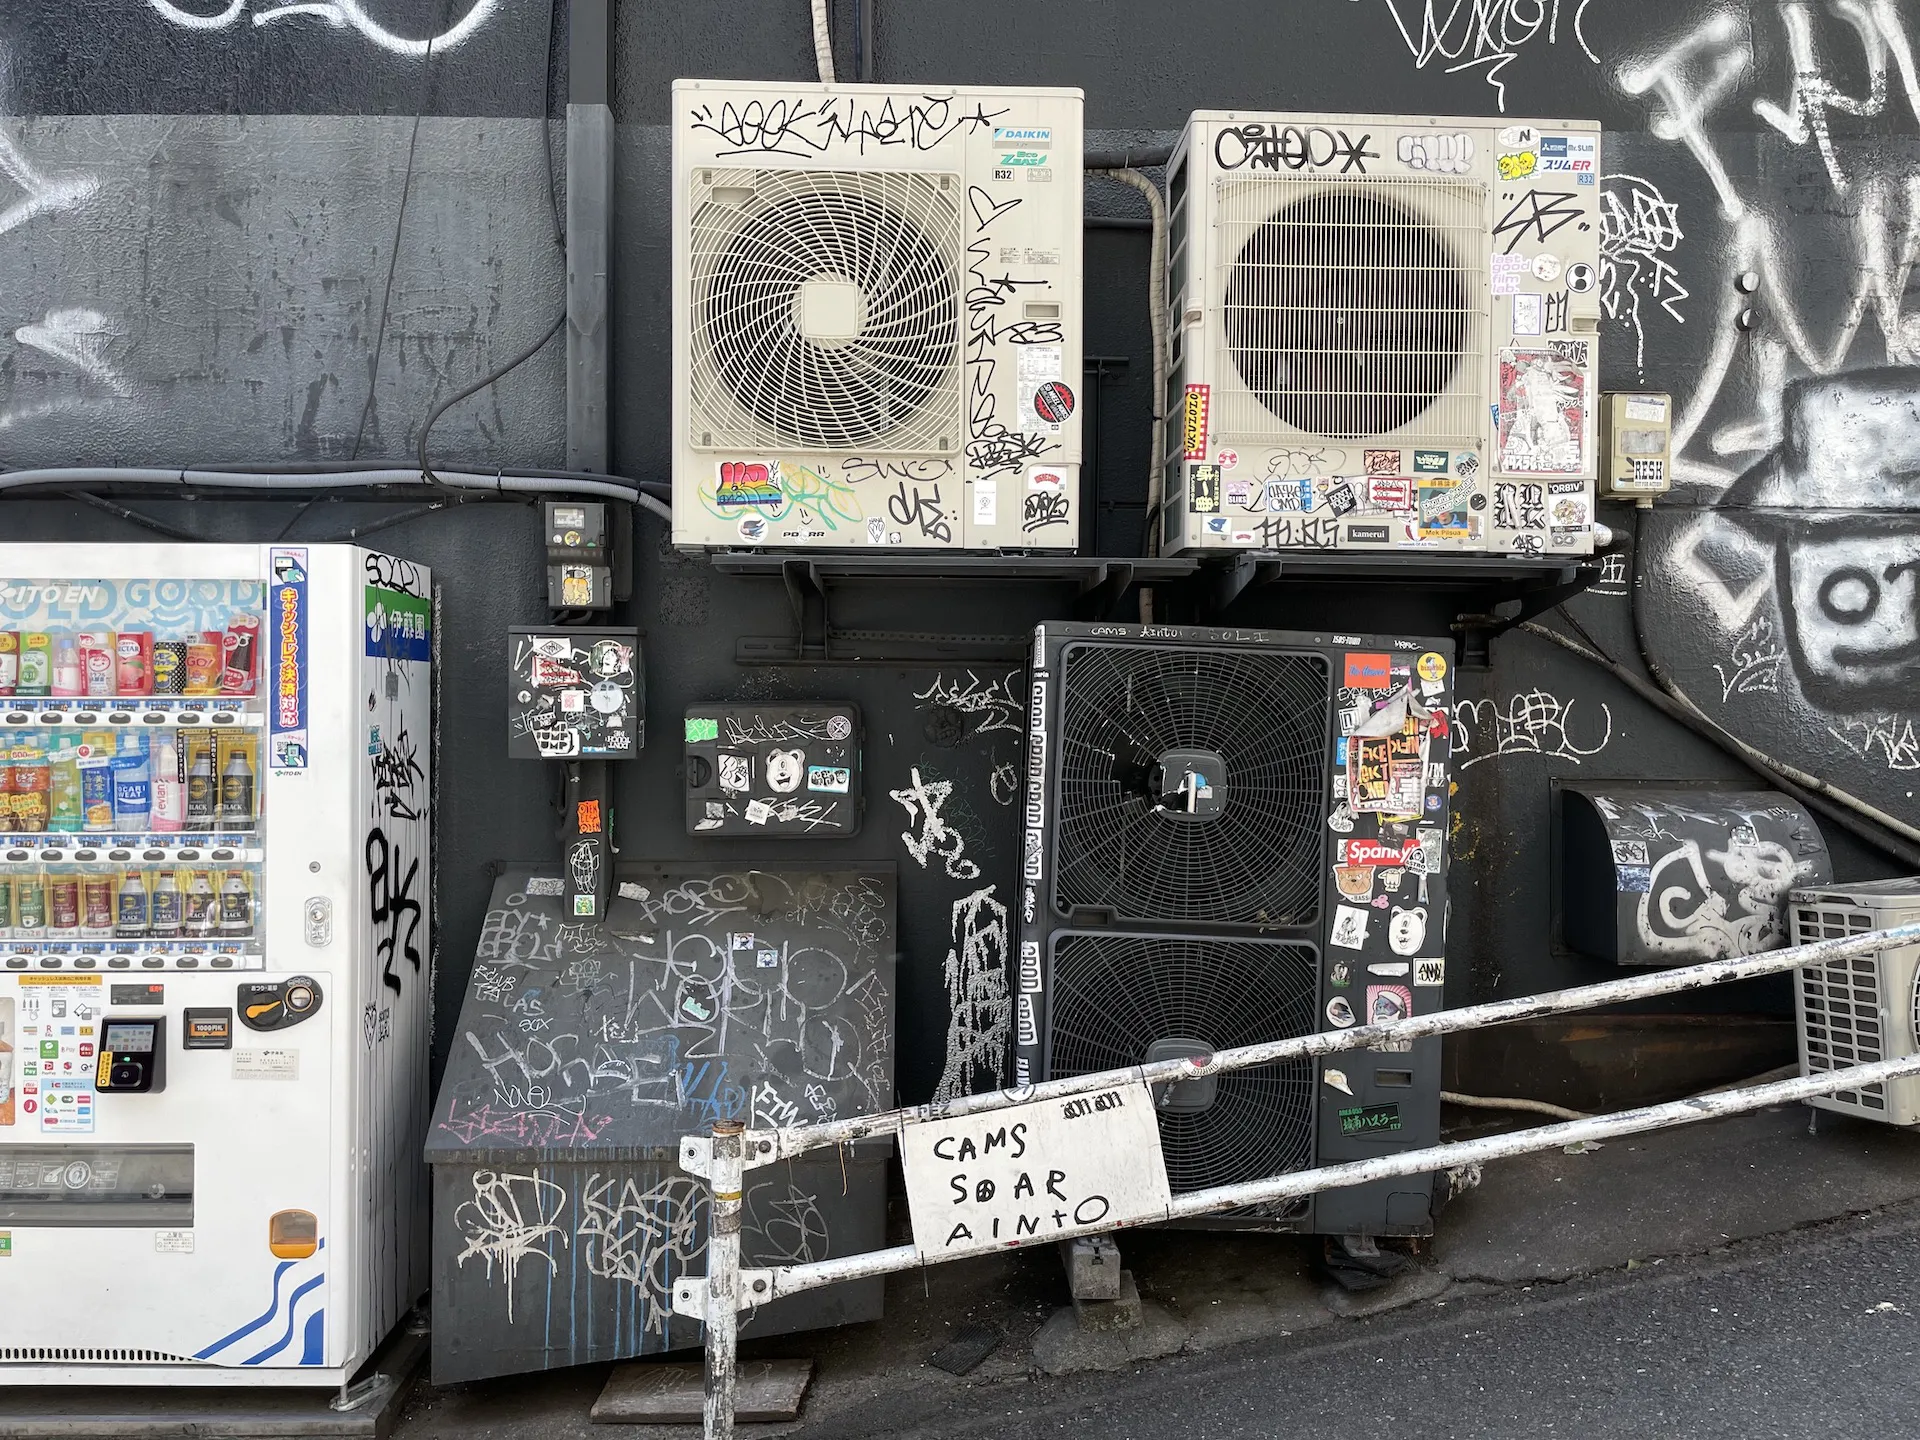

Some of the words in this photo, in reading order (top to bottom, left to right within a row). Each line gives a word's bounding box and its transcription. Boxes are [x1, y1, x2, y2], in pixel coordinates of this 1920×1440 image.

[1005, 130, 1050, 139] DAIKIN
[995, 171, 1012, 180] R32
[1578, 175, 1594, 184] R32
[1492, 262, 1531, 273] good
[1492, 274, 1520, 284] film
[1352, 529, 1385, 539] kamerui
[16, 585, 61, 605] ITO
[63, 585, 100, 605] EN
[389, 608, 425, 641] 伊藤園
[280, 588, 299, 728] キャッシュレス決済対応
[157, 783, 167, 811] evian
[1350, 842, 1418, 864] Spanky'
[933, 1122, 1027, 1162] CAMS
